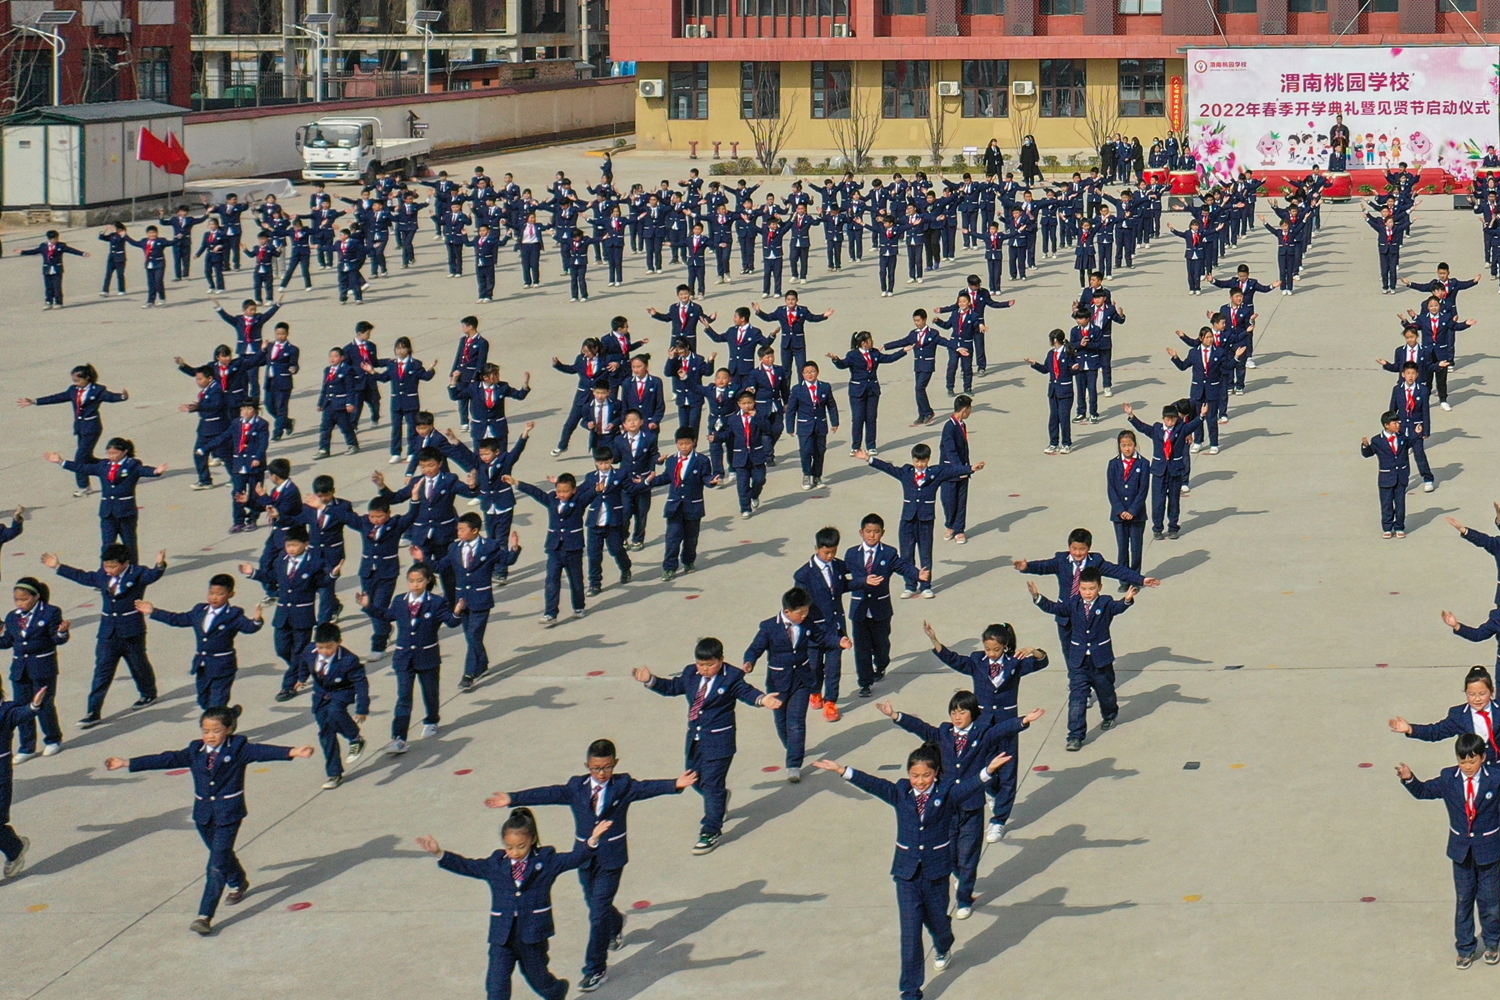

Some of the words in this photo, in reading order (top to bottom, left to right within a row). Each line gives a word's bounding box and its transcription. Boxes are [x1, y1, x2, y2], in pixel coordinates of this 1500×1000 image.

[1280, 72, 1410, 93] 渭南桃园学校
[1199, 100, 1491, 118] 2022年春季开学典礼暨见贤节启动仪式
